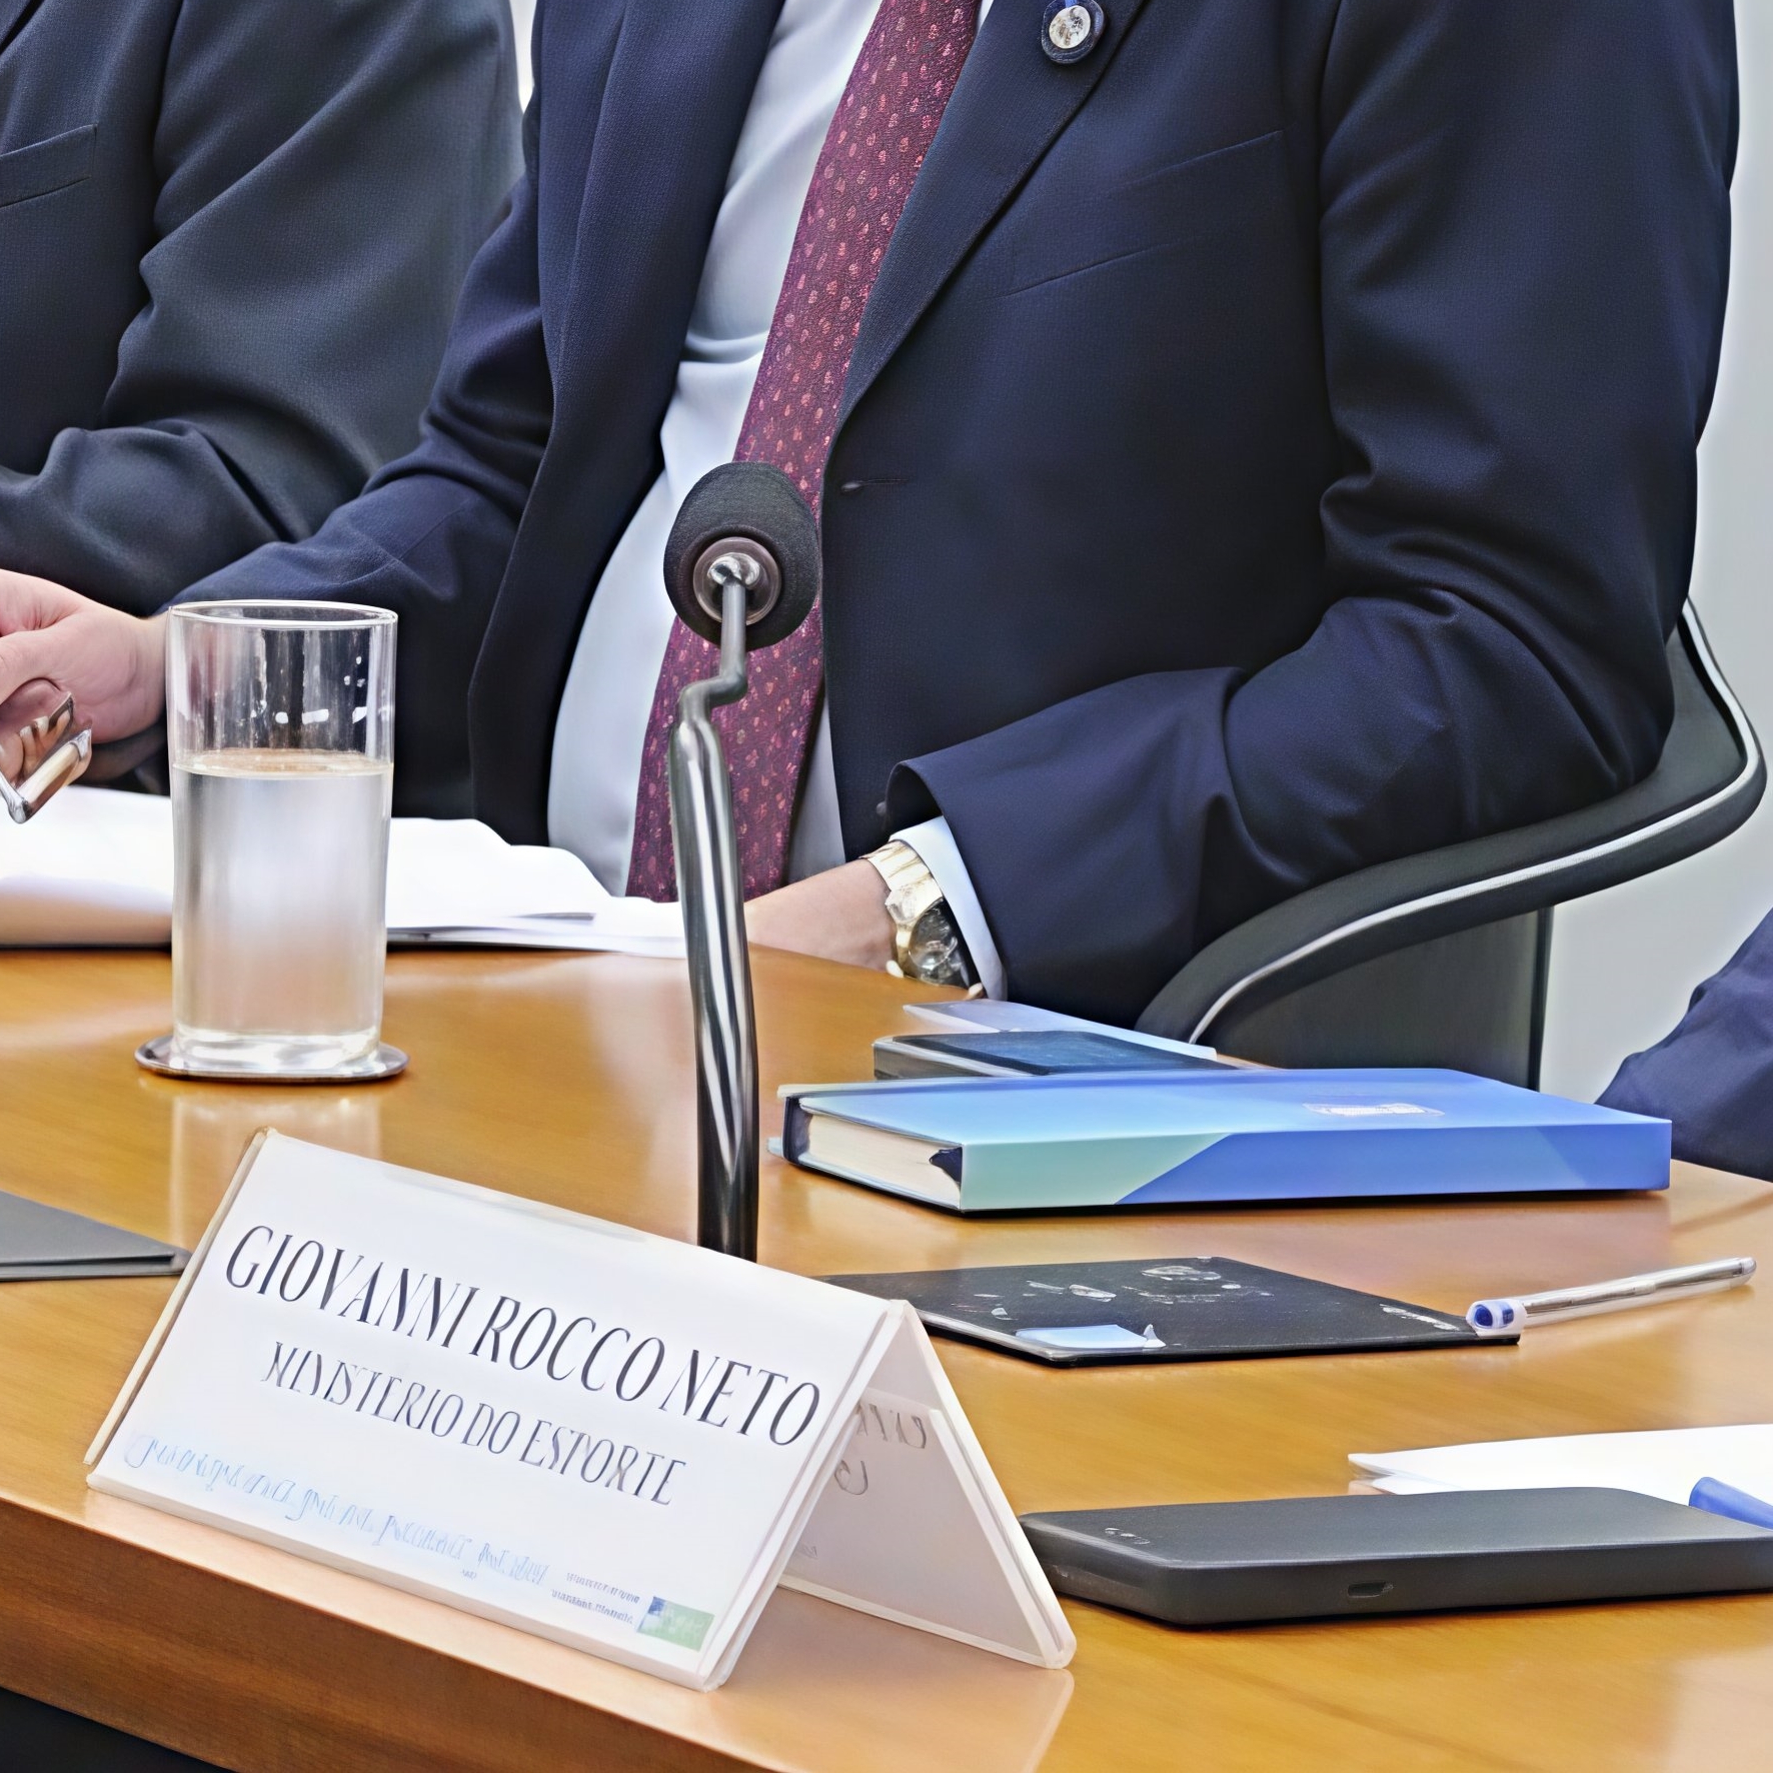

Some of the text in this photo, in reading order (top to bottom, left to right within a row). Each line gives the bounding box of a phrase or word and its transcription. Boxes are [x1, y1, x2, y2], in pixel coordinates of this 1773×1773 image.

[226, 1224, 481, 1349] GIOVANNI
[468, 1295, 666, 1403] ROCCO
[658, 1348, 821, 1446] NETO
[460, 1402, 521, 1453] DO
